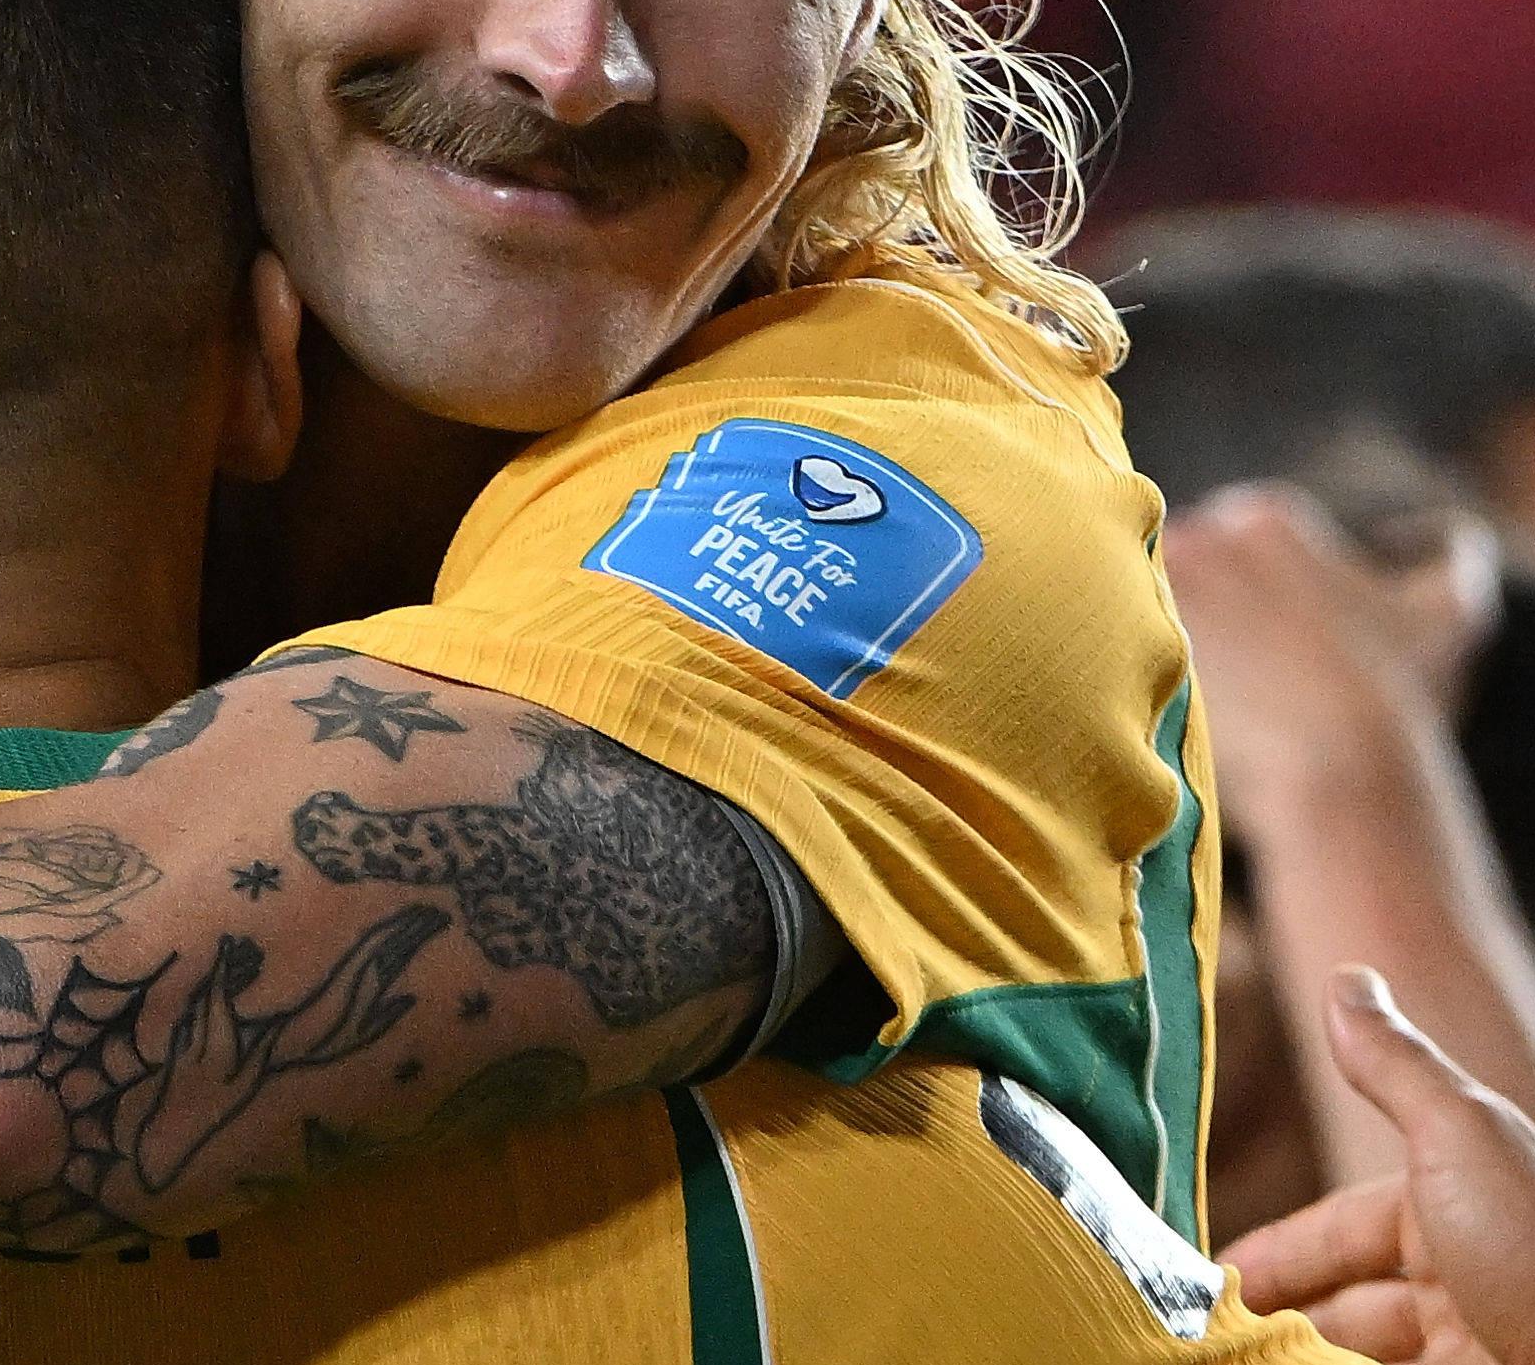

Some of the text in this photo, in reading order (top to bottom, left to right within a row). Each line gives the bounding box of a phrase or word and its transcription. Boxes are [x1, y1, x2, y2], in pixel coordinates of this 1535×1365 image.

[689, 524, 828, 627] PEACE
[712, 490, 858, 587] Unite For
[693, 572, 763, 629] FIFA
